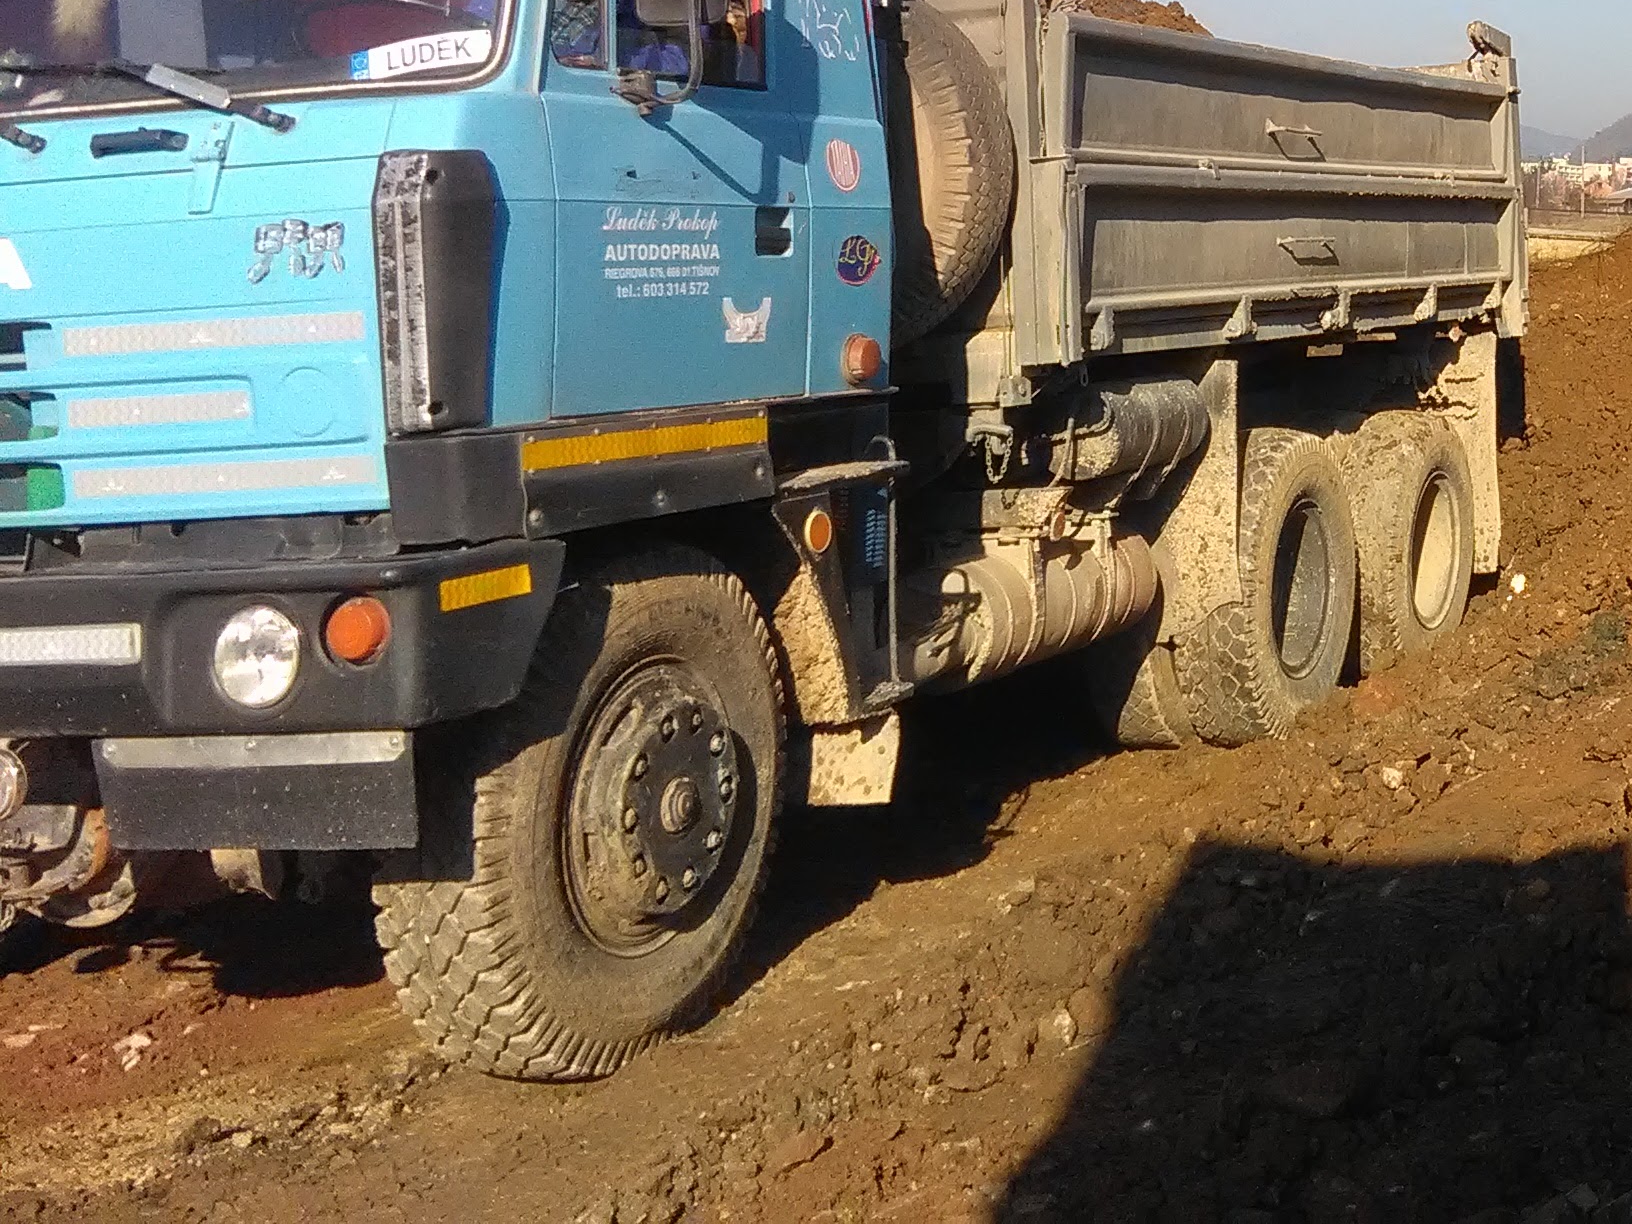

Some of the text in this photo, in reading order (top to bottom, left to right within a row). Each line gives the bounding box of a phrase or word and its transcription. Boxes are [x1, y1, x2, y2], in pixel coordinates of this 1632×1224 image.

[661, 206, 720, 240] Prokop
[603, 243, 720, 262] AUTODOPRAVA
[642, 282, 664, 297] 603
[666, 282, 687, 296] 314
[689, 281, 710, 296] 572
